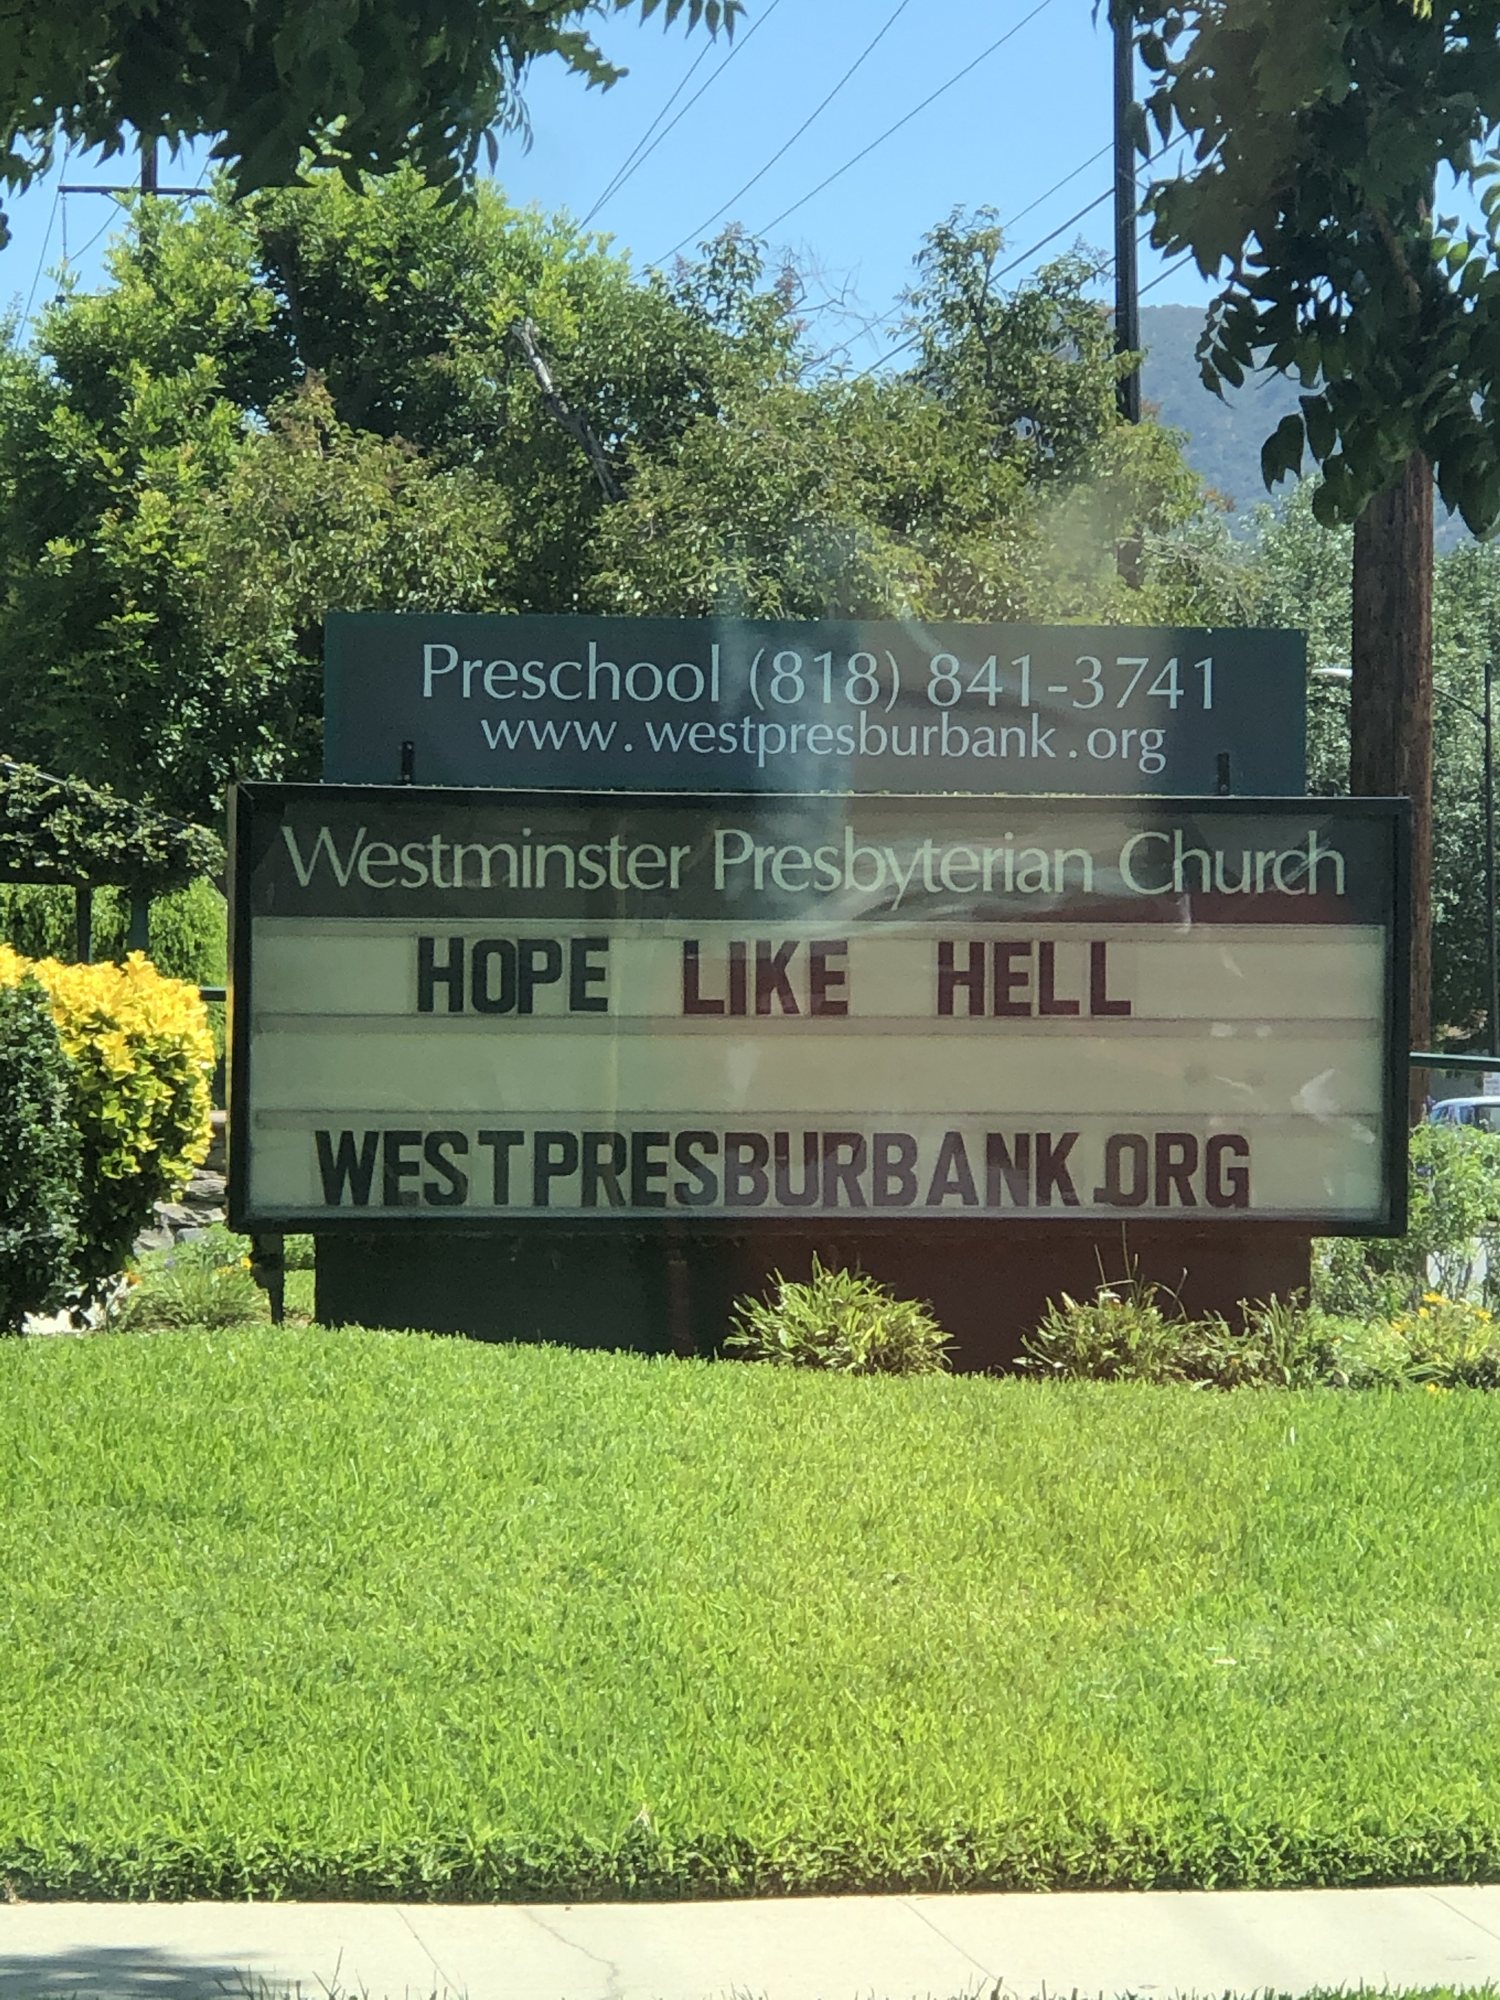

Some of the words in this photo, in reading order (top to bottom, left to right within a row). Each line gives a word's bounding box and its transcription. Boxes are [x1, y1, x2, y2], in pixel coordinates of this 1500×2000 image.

[422, 640, 720, 702] Preschool
[749, 647, 900, 711] (818)
[926, 652, 1213, 710] 841-3741
[281, 826, 690, 890] Westminster
[713, 825, 1093, 910] Presbyterian
[1119, 829, 1346, 896] Church
[417, 937, 609, 1014] HOPE
[683, 940, 848, 1016] LIKE
[938, 941, 1131, 1016] HELL
